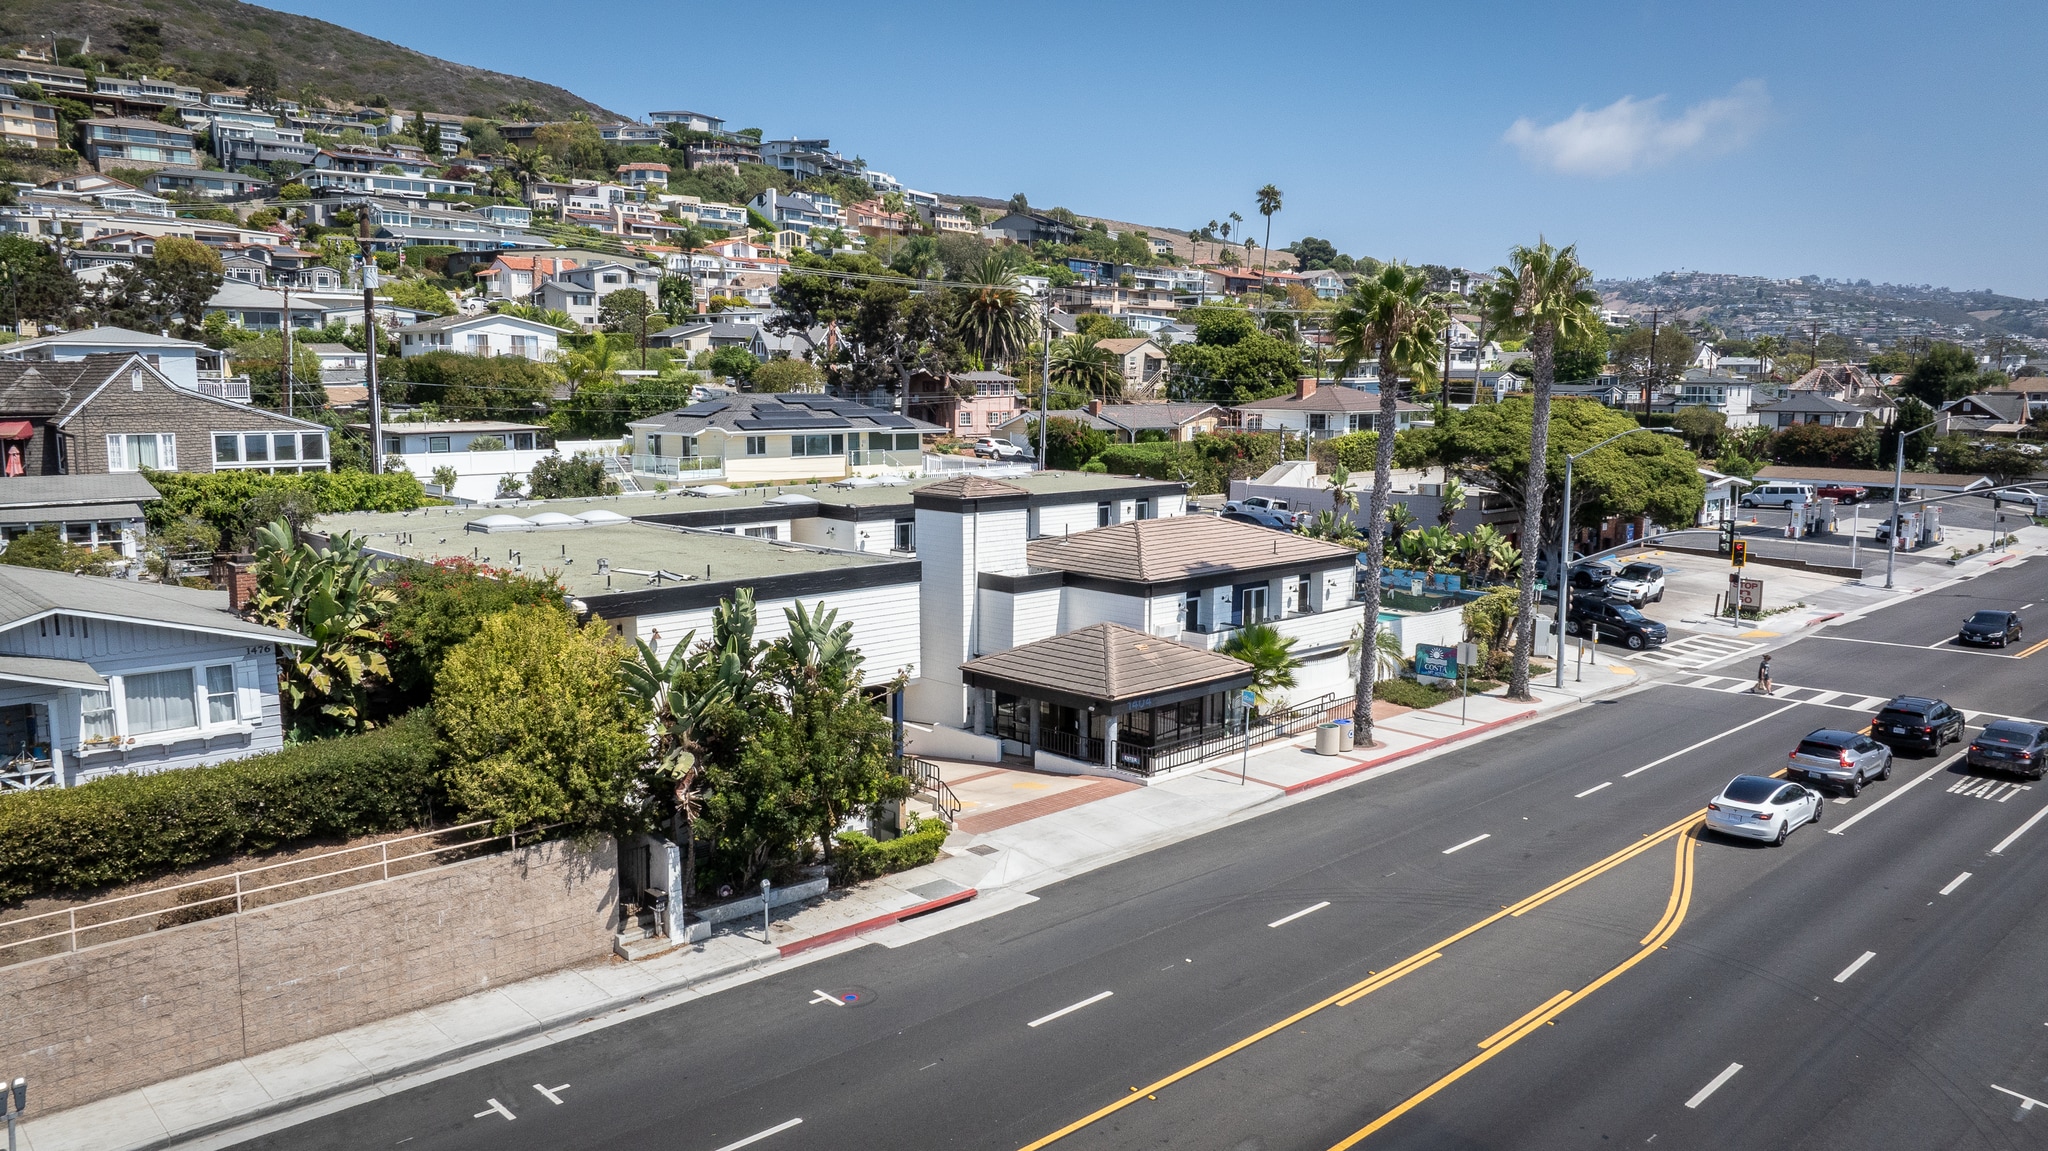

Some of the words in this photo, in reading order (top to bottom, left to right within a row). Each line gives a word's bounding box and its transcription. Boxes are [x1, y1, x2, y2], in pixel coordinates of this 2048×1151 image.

[246, 645, 271, 655] 1476
[1424, 663, 1448, 674] COSTA
[1127, 698, 1152, 711] 1404
[1124, 755, 1138, 763] ENTER
